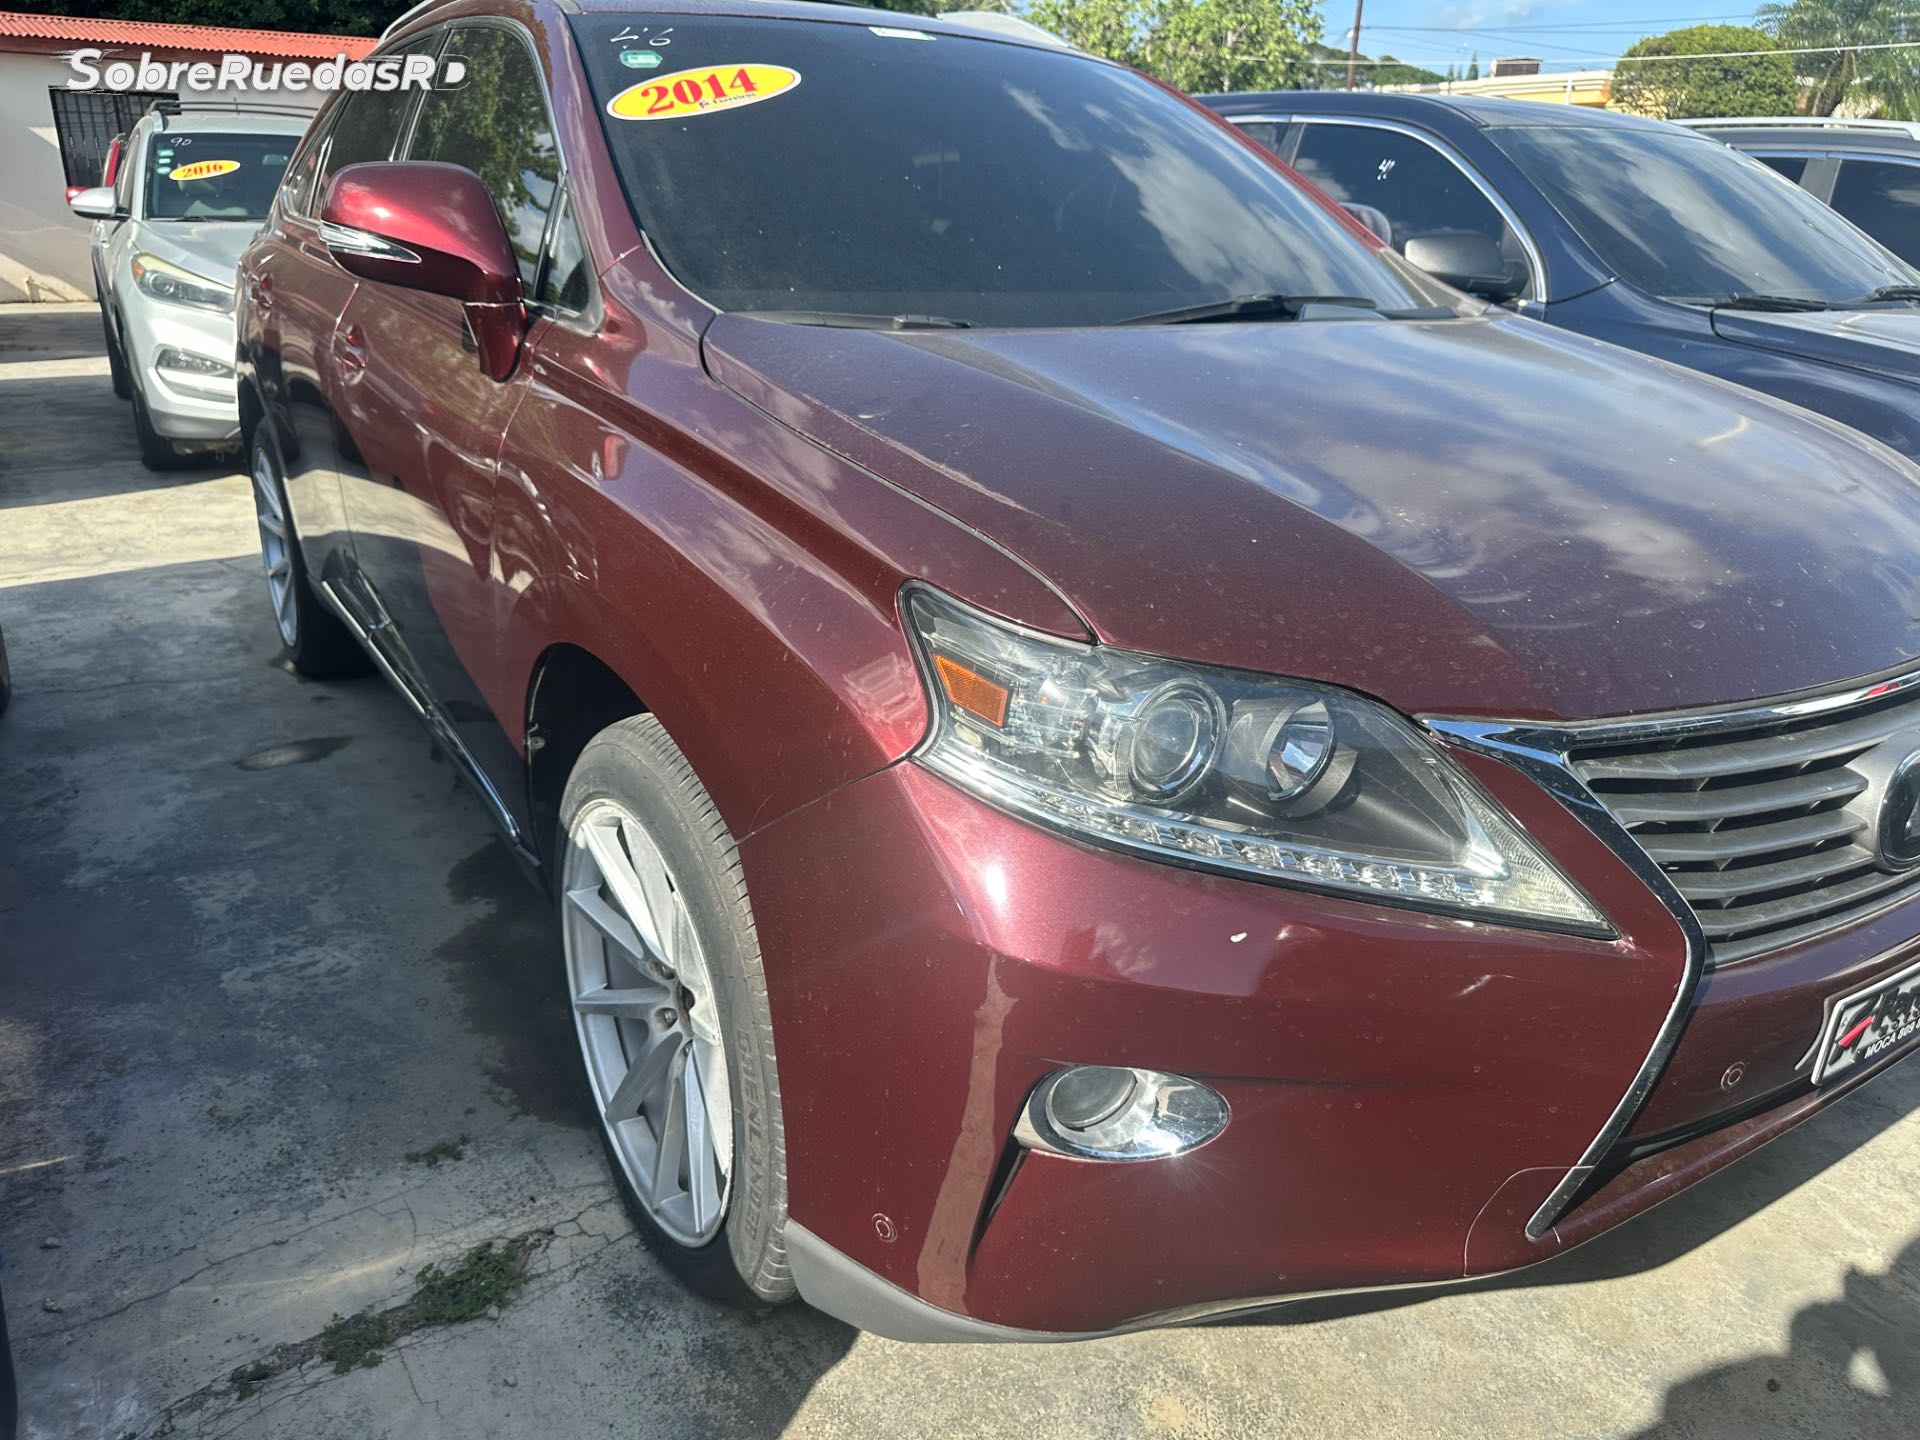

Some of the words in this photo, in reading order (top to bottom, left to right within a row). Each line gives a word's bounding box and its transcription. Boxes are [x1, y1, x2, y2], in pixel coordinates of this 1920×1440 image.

[641, 68, 758, 115] 2014
[182, 163, 223, 178] 2016
[1864, 1032, 1896, 1059] MOCA
